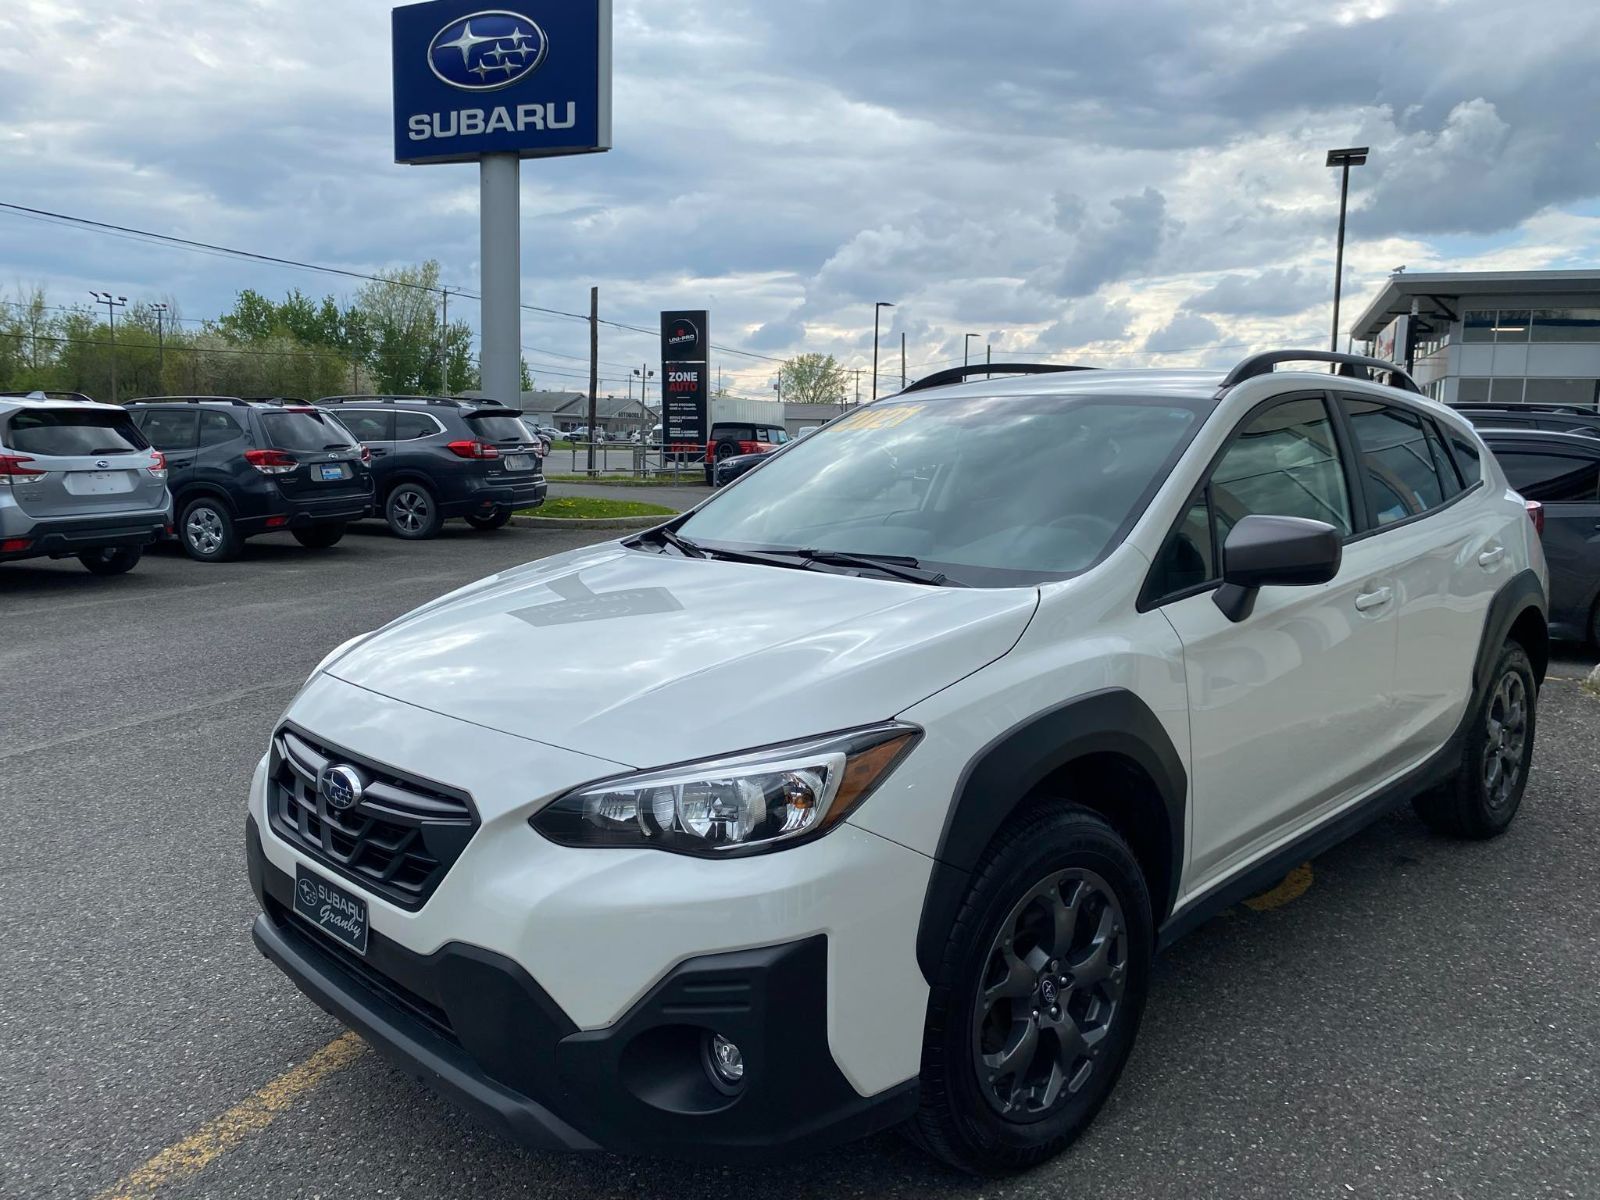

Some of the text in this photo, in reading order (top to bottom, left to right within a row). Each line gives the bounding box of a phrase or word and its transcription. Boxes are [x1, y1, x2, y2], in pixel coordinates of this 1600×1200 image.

[408, 101, 576, 141] SUBARU
[668, 371, 698, 382] ZONE
[668, 382, 698, 392] AUTO
[318, 884, 364, 922] SUBARU
[319, 904, 361, 940] Granby
